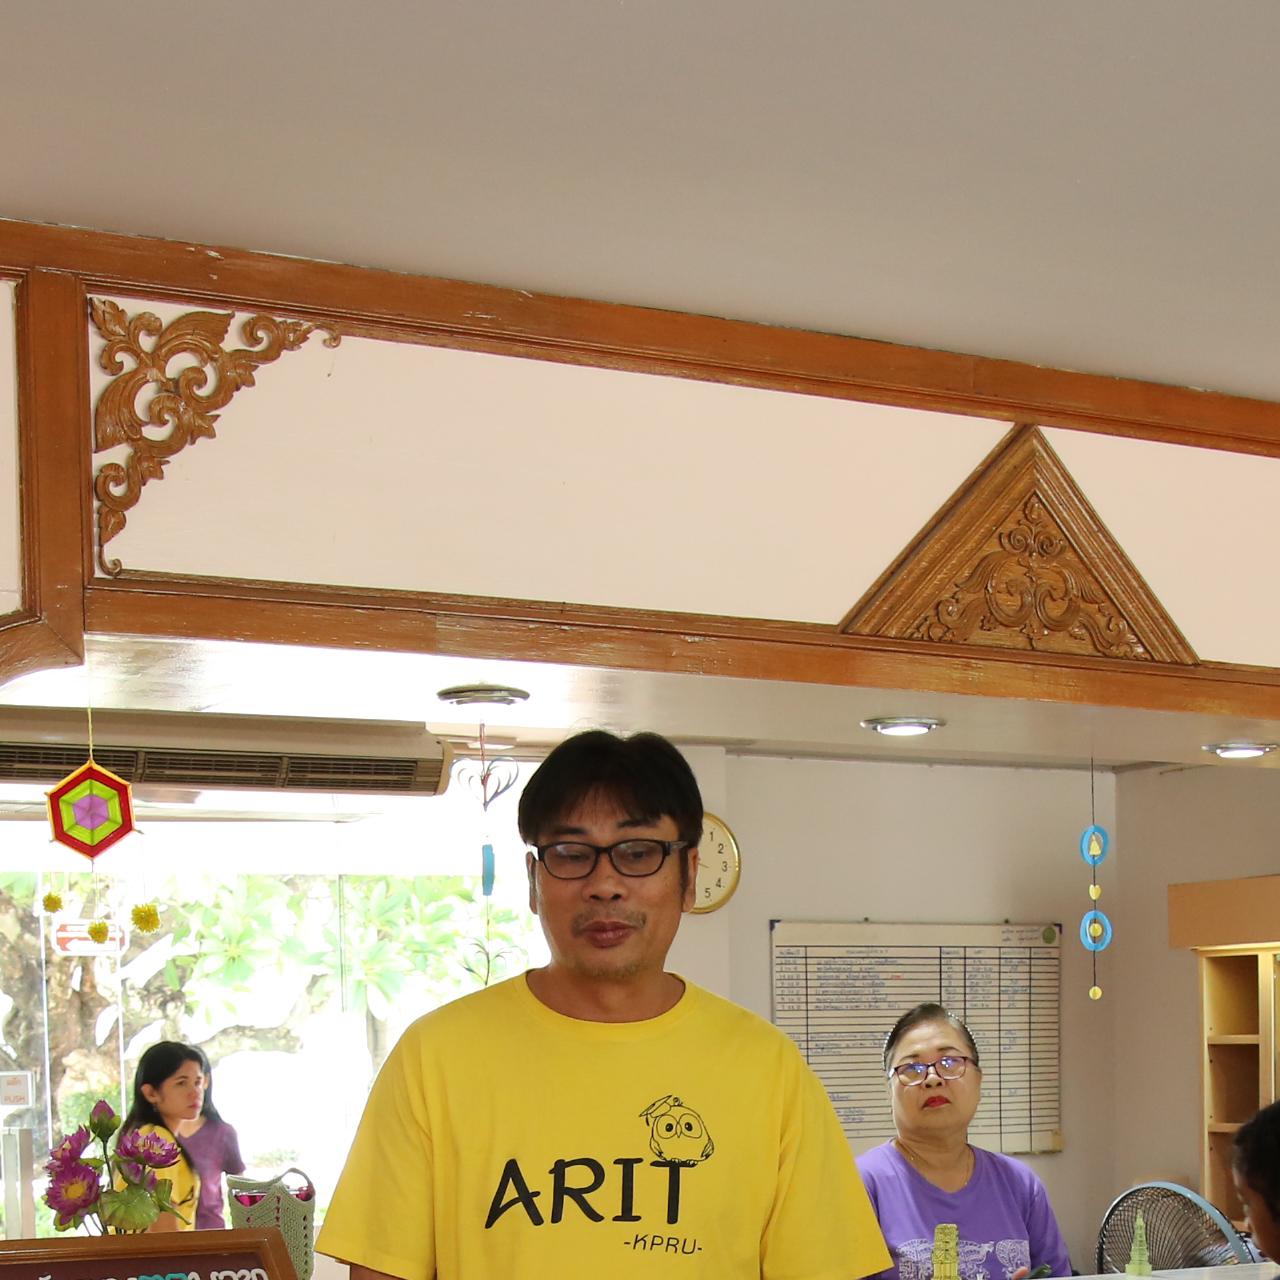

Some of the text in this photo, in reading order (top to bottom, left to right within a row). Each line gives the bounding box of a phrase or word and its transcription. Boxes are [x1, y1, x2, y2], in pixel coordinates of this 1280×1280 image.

[709, 831, 714, 841] 1
[717, 843, 724, 854] 2
[721, 861, 728, 872] 3
[715, 877, 722, 888] 4
[704, 887, 711, 898] 5
[484, 1157, 698, 1229] ARIT
